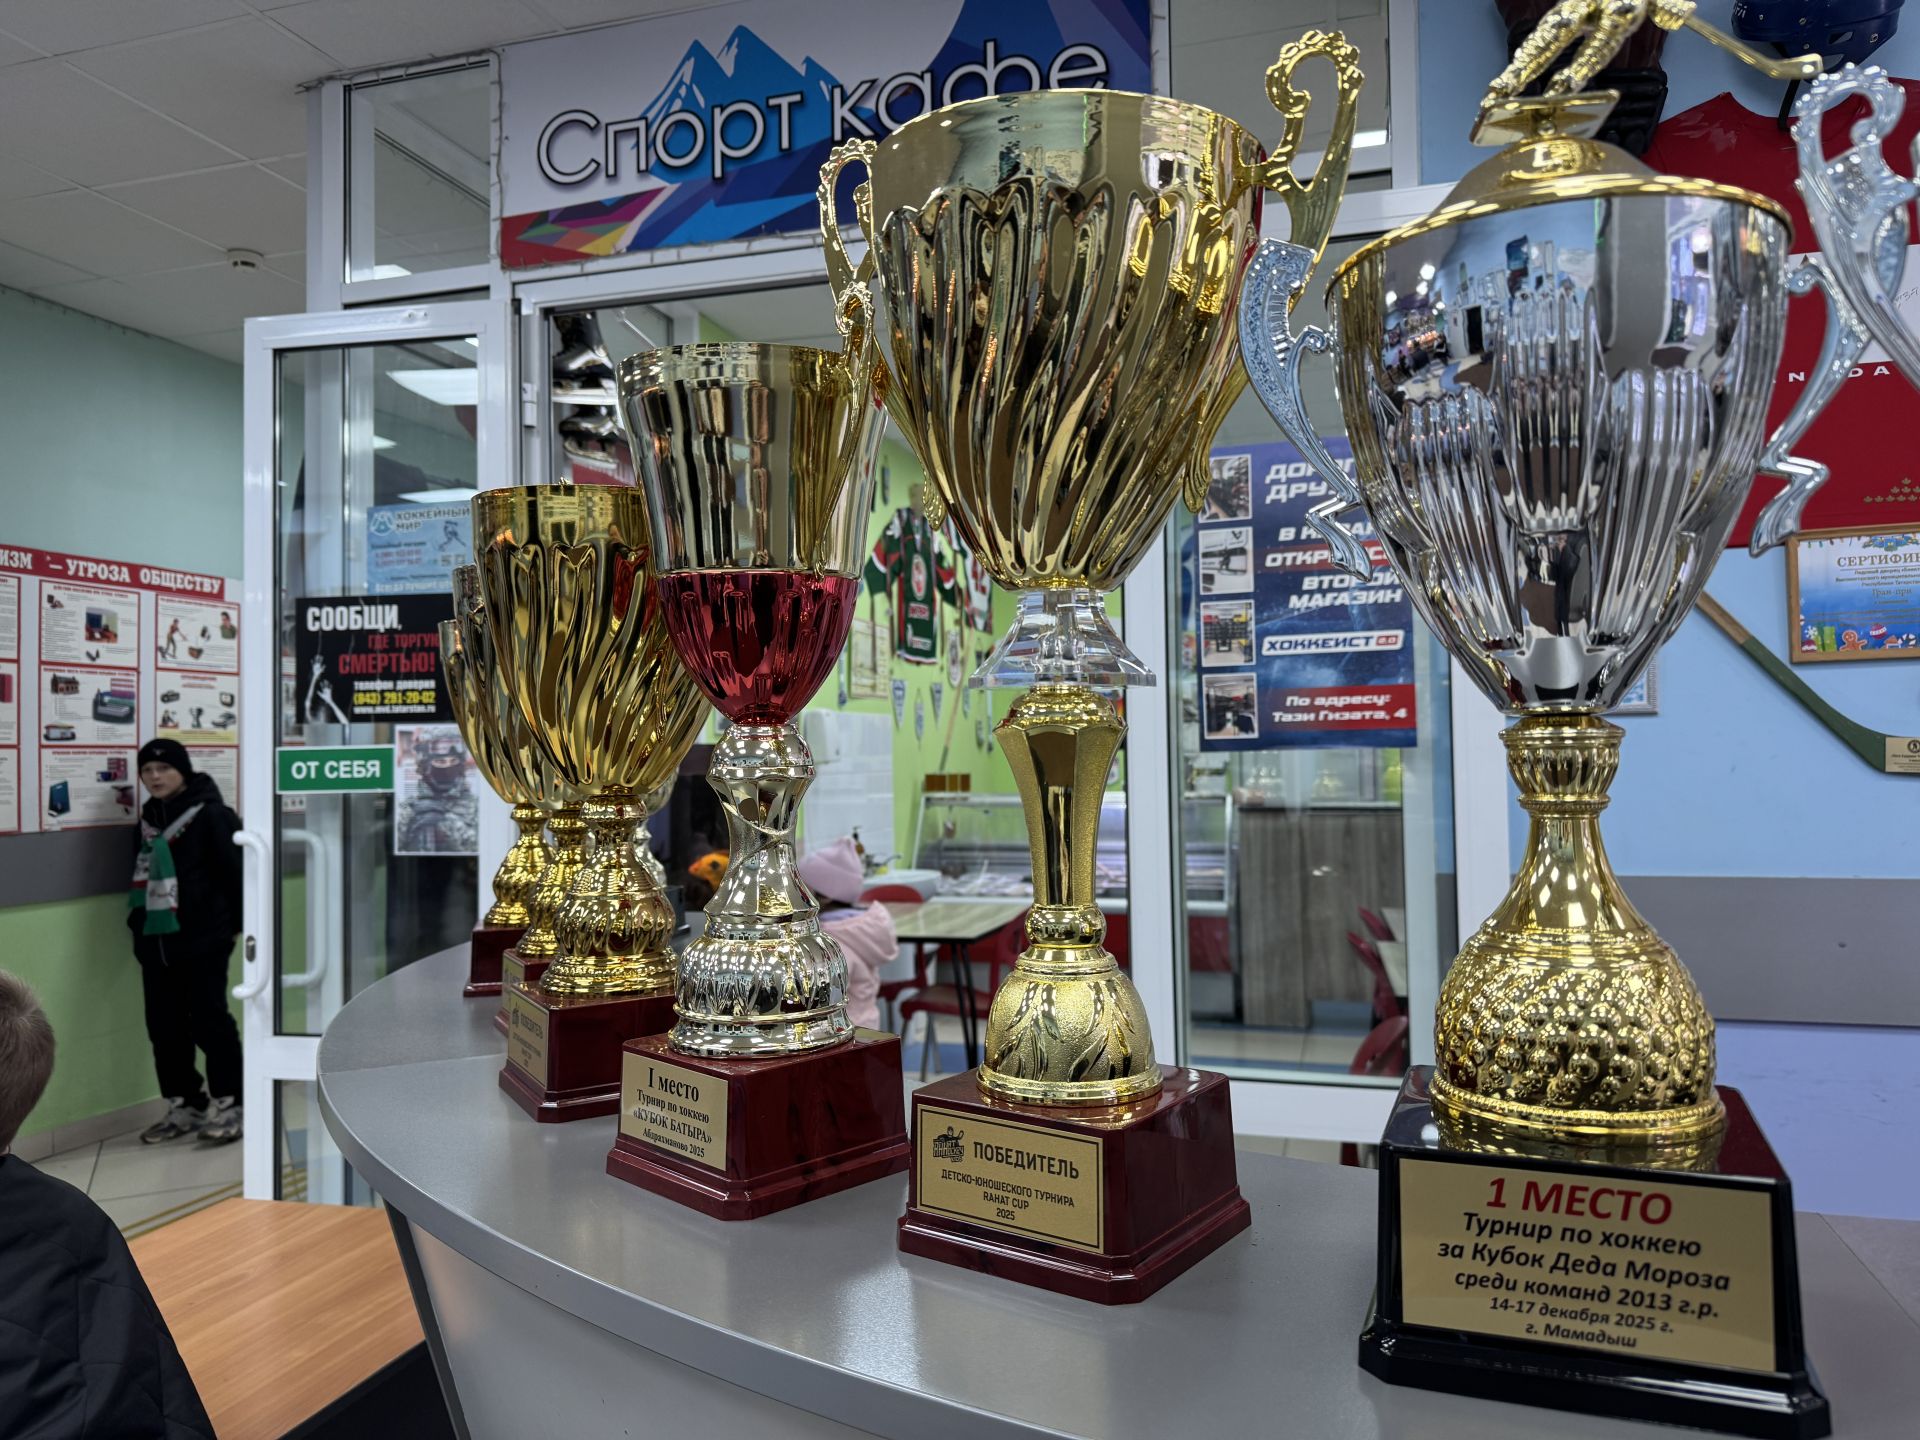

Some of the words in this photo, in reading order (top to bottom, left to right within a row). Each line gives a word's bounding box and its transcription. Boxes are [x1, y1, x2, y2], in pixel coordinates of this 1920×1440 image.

[537, 92, 804, 184] Спорт
[396, 507, 470, 520] ХОККЕЙНЫЙ
[396, 521, 421, 530] МИР
[1278, 527, 1296, 541] В
[66, 559, 131, 583] УГРОЗА
[140, 567, 221, 594] ОБЩЕСТВУ
[1288, 588, 1403, 609] МАГАЗИН
[306, 604, 402, 633] СООБЩИ,
[368, 634, 389, 649] ГДЕ
[1267, 636, 1373, 651] ХОККЕИСТ
[339, 652, 435, 675] СМЕРТЬЮ!
[1286, 695, 1310, 706] По
[1314, 694, 1392, 707] адресу:
[1272, 711, 1316, 722] Тази
[1393, 708, 1408, 719] 4
[291, 761, 320, 779] ОТ
[324, 760, 381, 779] СЕБЯ
[658, 1076, 699, 1102] место
[637, 1089, 666, 1112] Турнир
[667, 1103, 677, 1113] по
[679, 1105, 709, 1123] хоккею
[633, 1107, 669, 1129] «КУБОК
[670, 1118, 712, 1144] БАТЫРА»
[689, 1143, 705, 1158] 2025
[974, 1141, 1080, 1180] ПОБЕДИТЕЛЬ
[941, 1169, 1032, 1198] ДЕТСКО-ЮНОШЕСКОГО
[1034, 1189, 1075, 1208] ТУРНИРА
[996, 1207, 1015, 1220] 2025
[1012, 1198, 1029, 1210] CUP
[1486, 1178, 1507, 1209] 1
[1521, 1180, 1673, 1225] МЕСТО
[1463, 1211, 1553, 1243] Турнир
[1560, 1228, 1592, 1245] по
[1598, 1230, 1701, 1257] хоккею
[1437, 1242, 1465, 1259] за
[1471, 1242, 1544, 1269] Кубок
[1549, 1253, 1617, 1277] Деда
[1624, 1259, 1730, 1291] Мороза
[1455, 1269, 1517, 1292] среди
[1523, 1279, 1611, 1304] команд
[1617, 1288, 1671, 1312] 2013
[1678, 1300, 1719, 1319] г.р.
[1489, 1297, 1534, 1315] 14-17
[1539, 1301, 1610, 1325] декабря
[1615, 1312, 1655, 1331] 2025
[1659, 1319, 1674, 1334] г.
[1525, 1323, 1539, 1336] г.
[1544, 1324, 1638, 1348] Мамадыш
